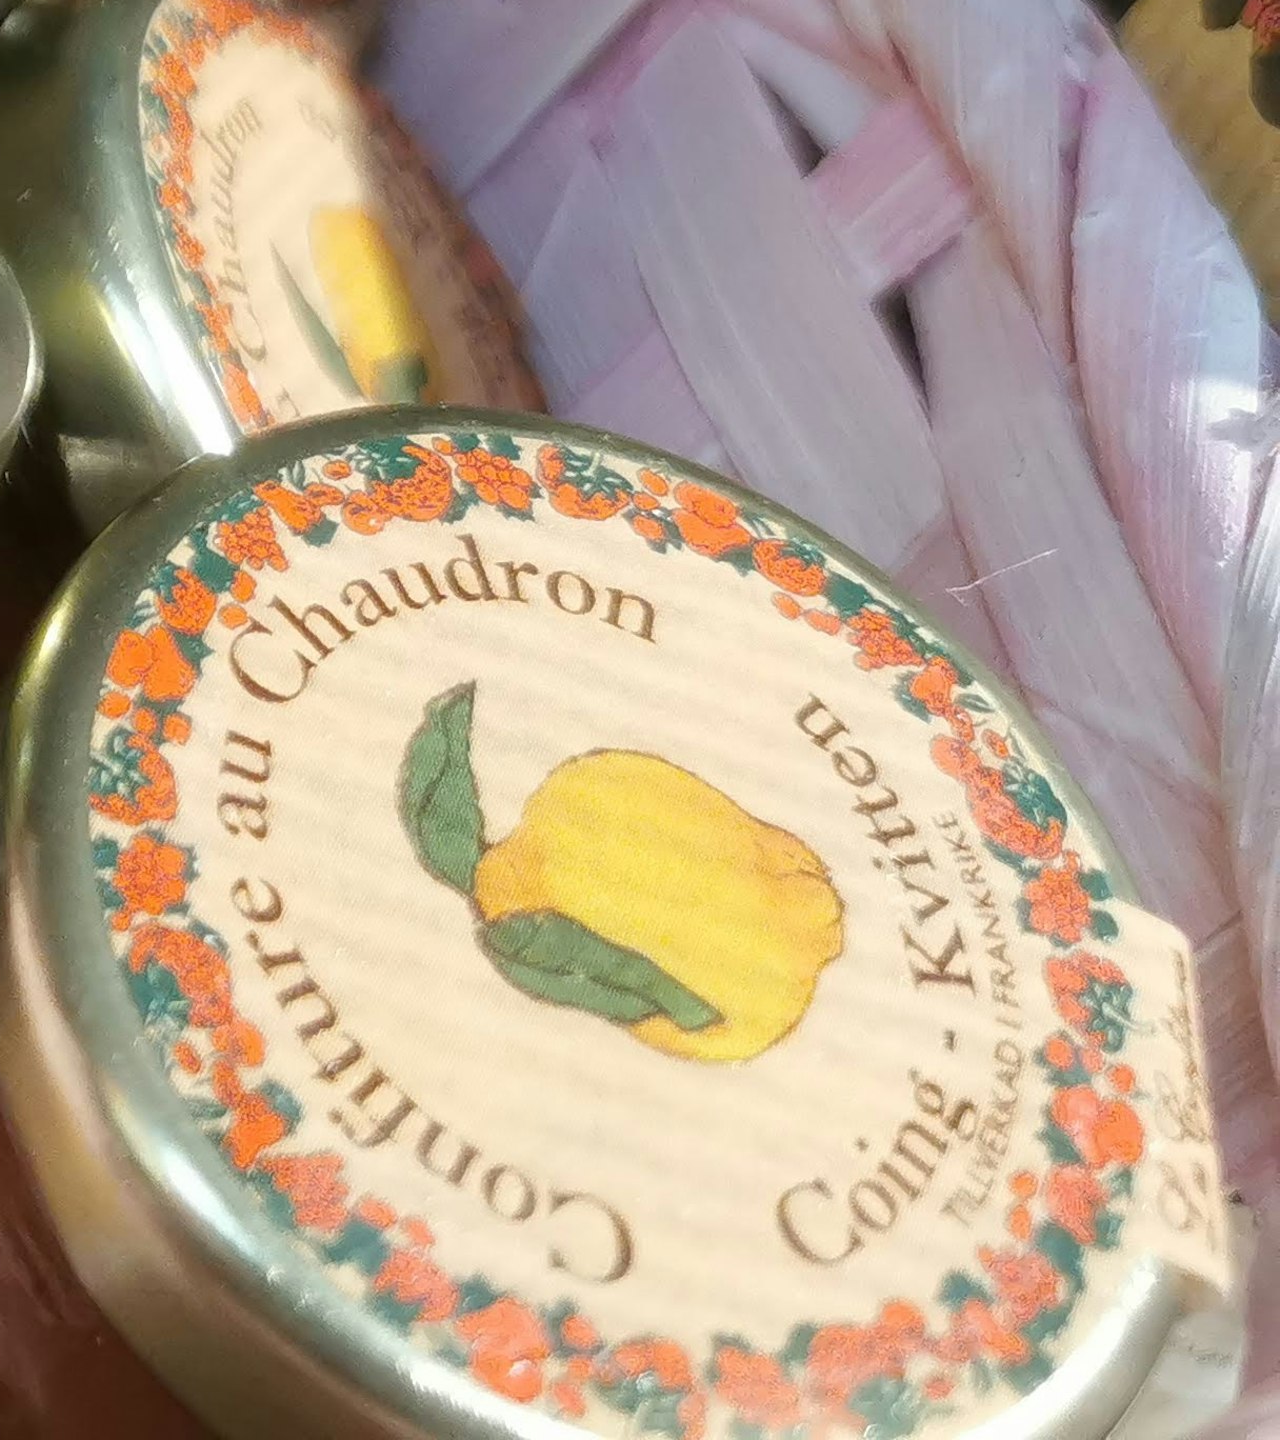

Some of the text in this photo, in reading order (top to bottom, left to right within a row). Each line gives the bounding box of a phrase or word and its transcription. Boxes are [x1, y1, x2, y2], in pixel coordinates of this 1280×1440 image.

[202, 98, 266, 361] Chaudron
[214, 533, 660, 1286] Confiture au Chaudron
[794, 690, 980, 1000] Kvitten
[933, 810, 1021, 1010] FRANKRIKE
[774, 1063, 978, 1270] Coing
[939, 1038, 1022, 1229] TILLVERKAD
